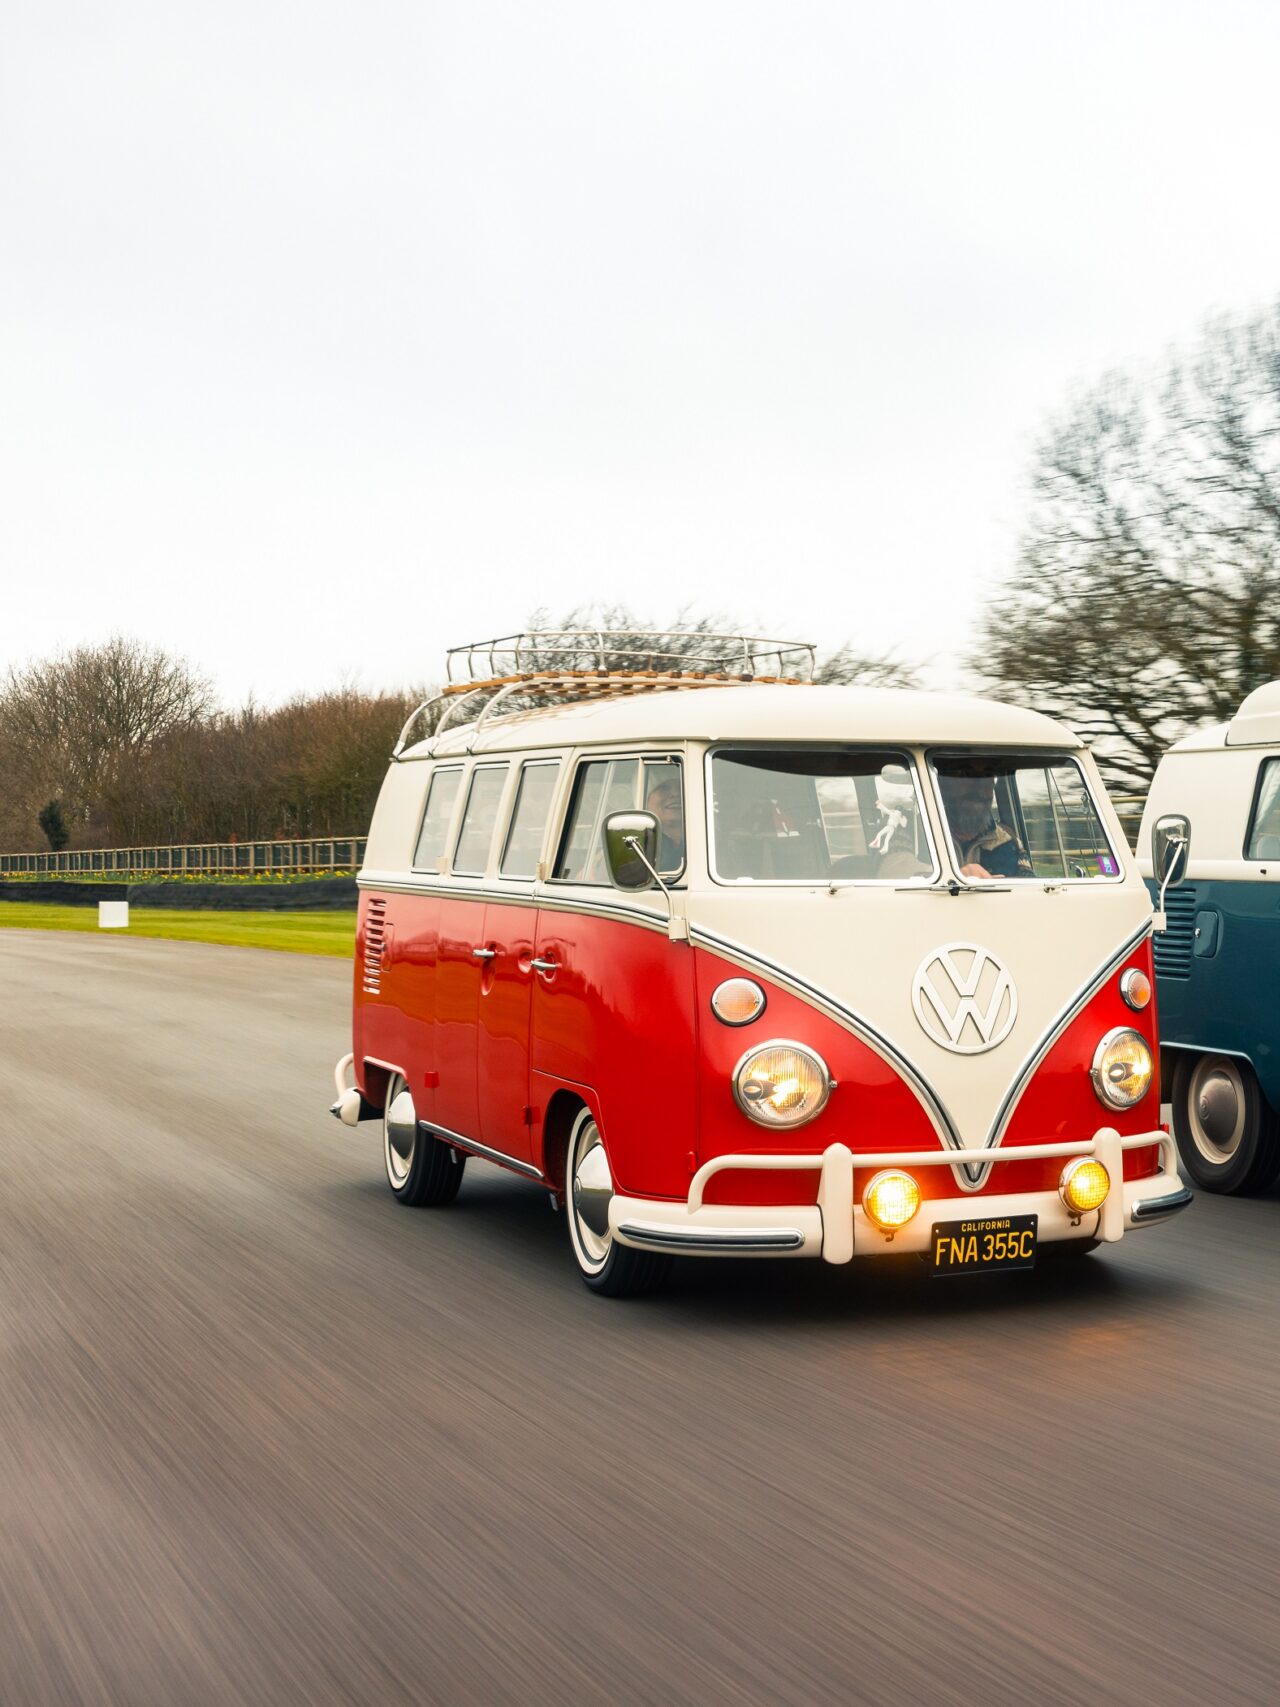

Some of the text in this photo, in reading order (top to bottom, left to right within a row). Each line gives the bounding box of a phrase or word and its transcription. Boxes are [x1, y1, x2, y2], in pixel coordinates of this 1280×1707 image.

[912, 942, 1018, 1055] VW
[961, 1219, 1011, 1232] CALIFORNIA
[935, 1230, 1034, 1266] FNA 355C
